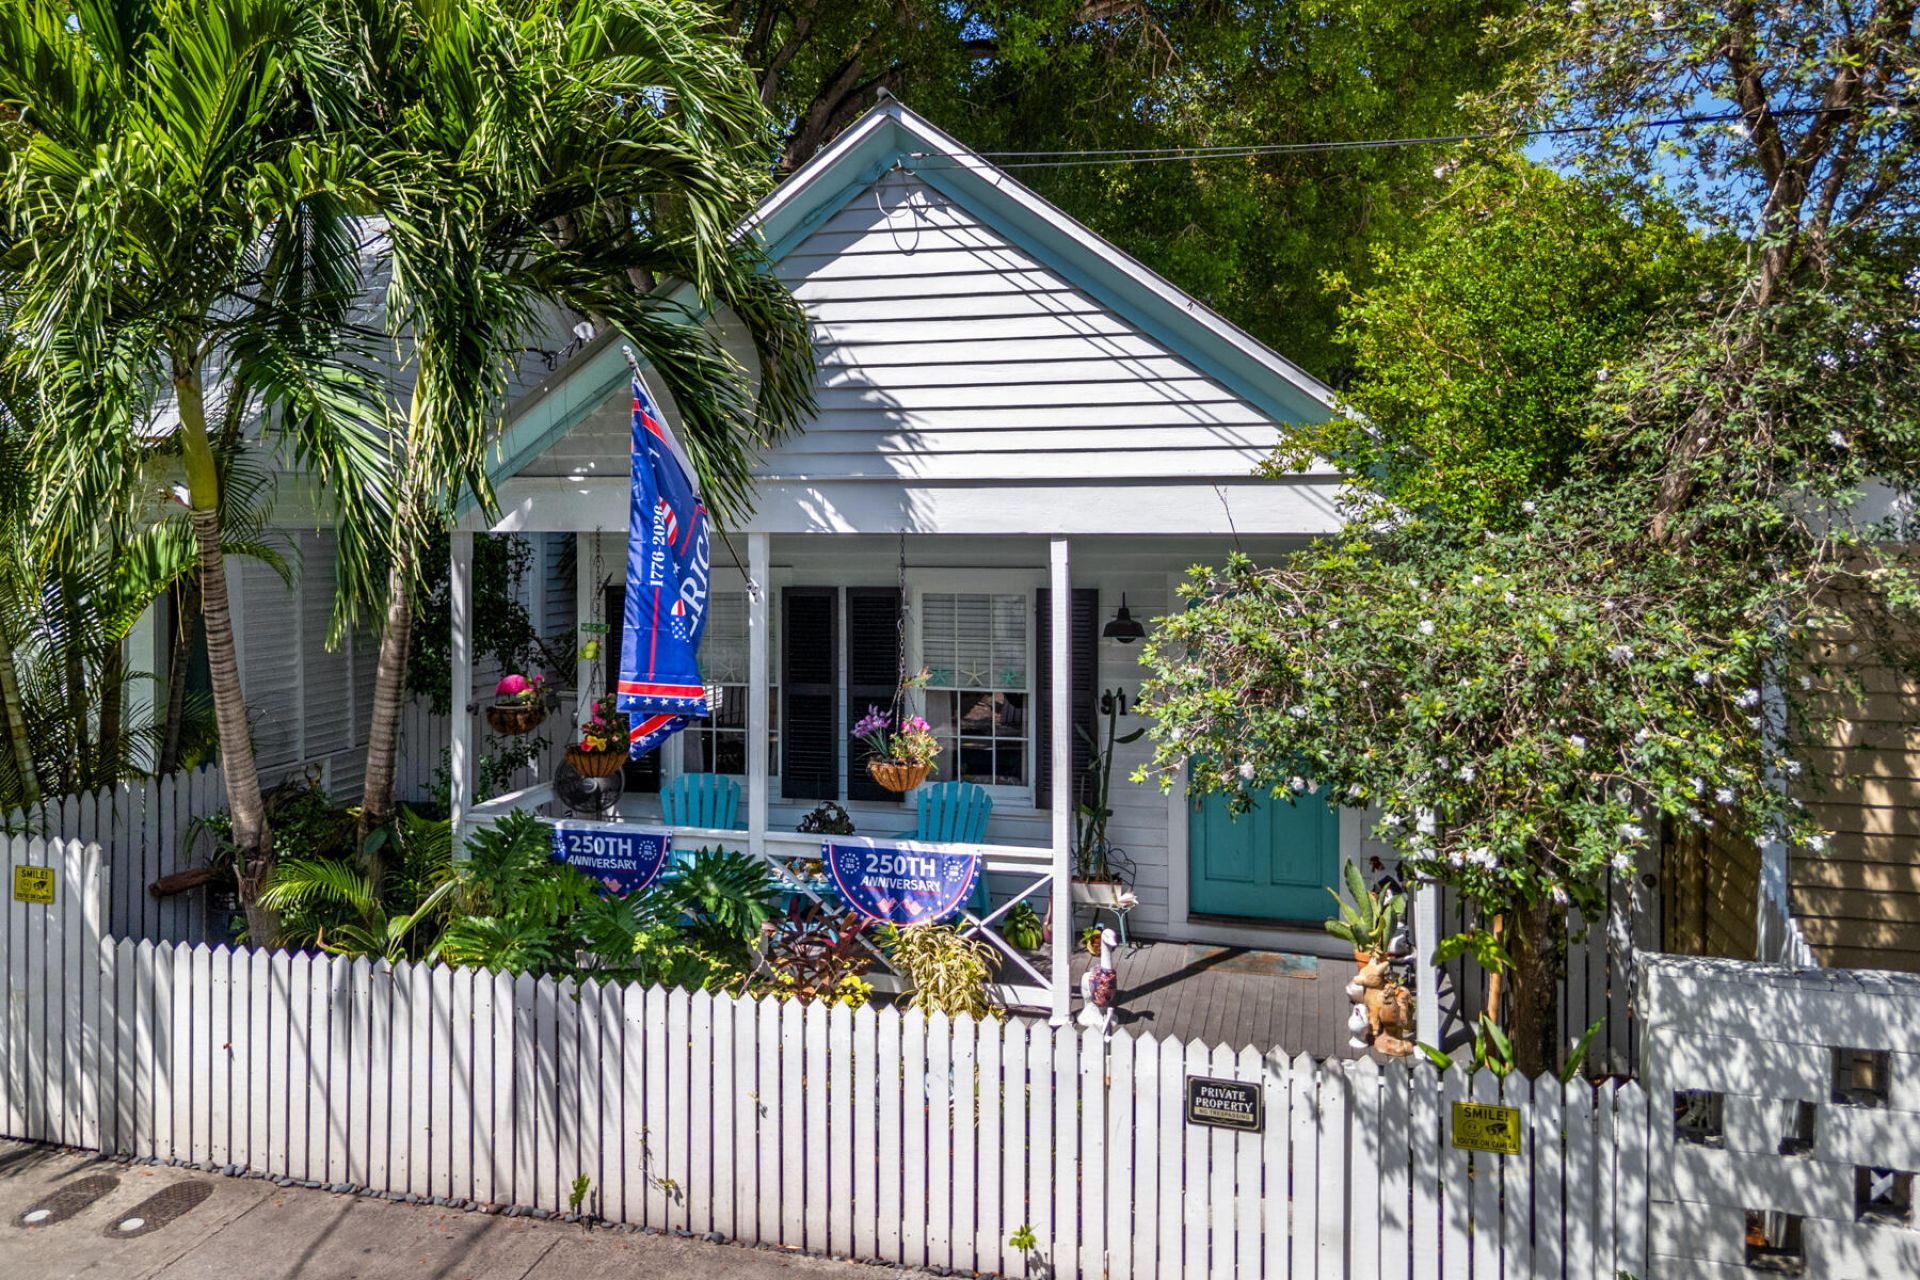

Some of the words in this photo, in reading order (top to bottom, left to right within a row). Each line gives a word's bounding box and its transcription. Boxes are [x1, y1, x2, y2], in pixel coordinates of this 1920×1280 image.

[568, 835, 633, 857] 250TH
[566, 855, 638, 870] ANNIVERSARY
[865, 853, 936, 878] 250TH
[21, 869, 49, 880] SMILE!
[860, 875, 941, 892] ANNIVERSARY
[1201, 1086, 1246, 1101] PRIVATE
[1195, 1097, 1253, 1113] PROPERTY
[1463, 1107, 1508, 1122] SMILE!
